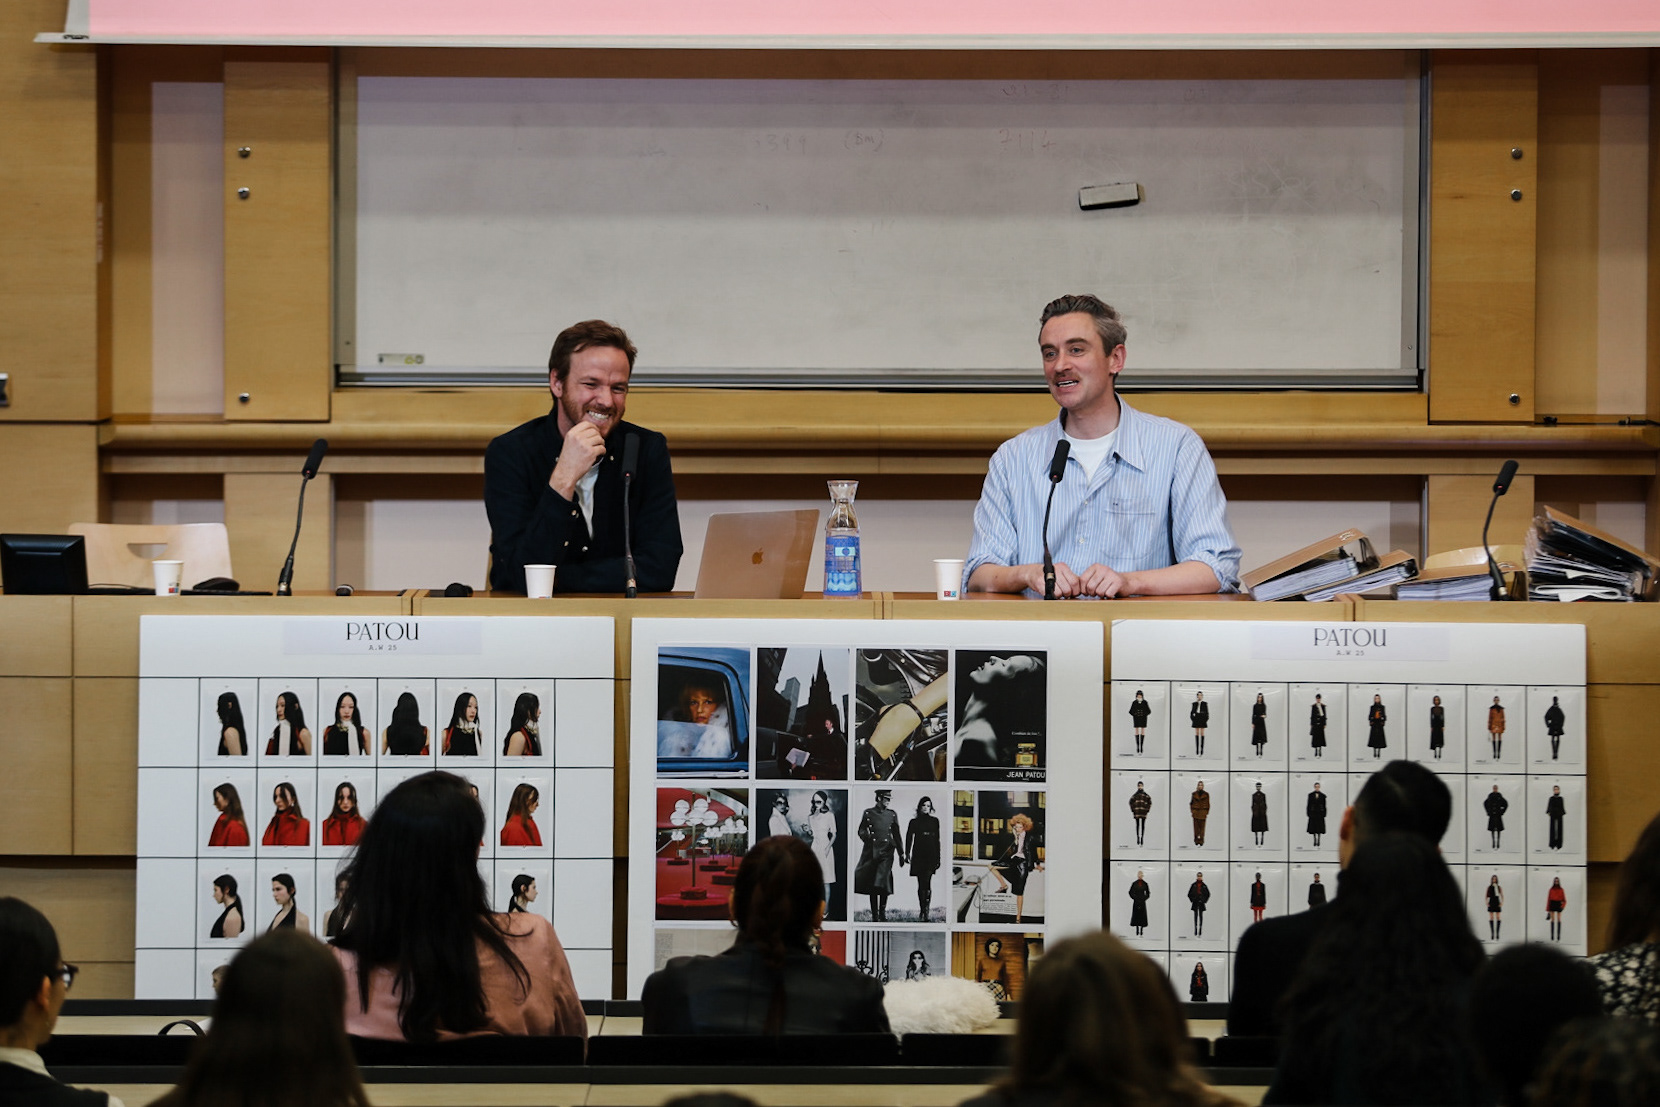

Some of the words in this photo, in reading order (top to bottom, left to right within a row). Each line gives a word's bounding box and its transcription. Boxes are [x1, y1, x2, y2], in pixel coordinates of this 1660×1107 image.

[346, 622, 419, 641] PATOU
[1313, 627, 1387, 647] PATOU
[1025, 771, 1046, 779] PATOU
